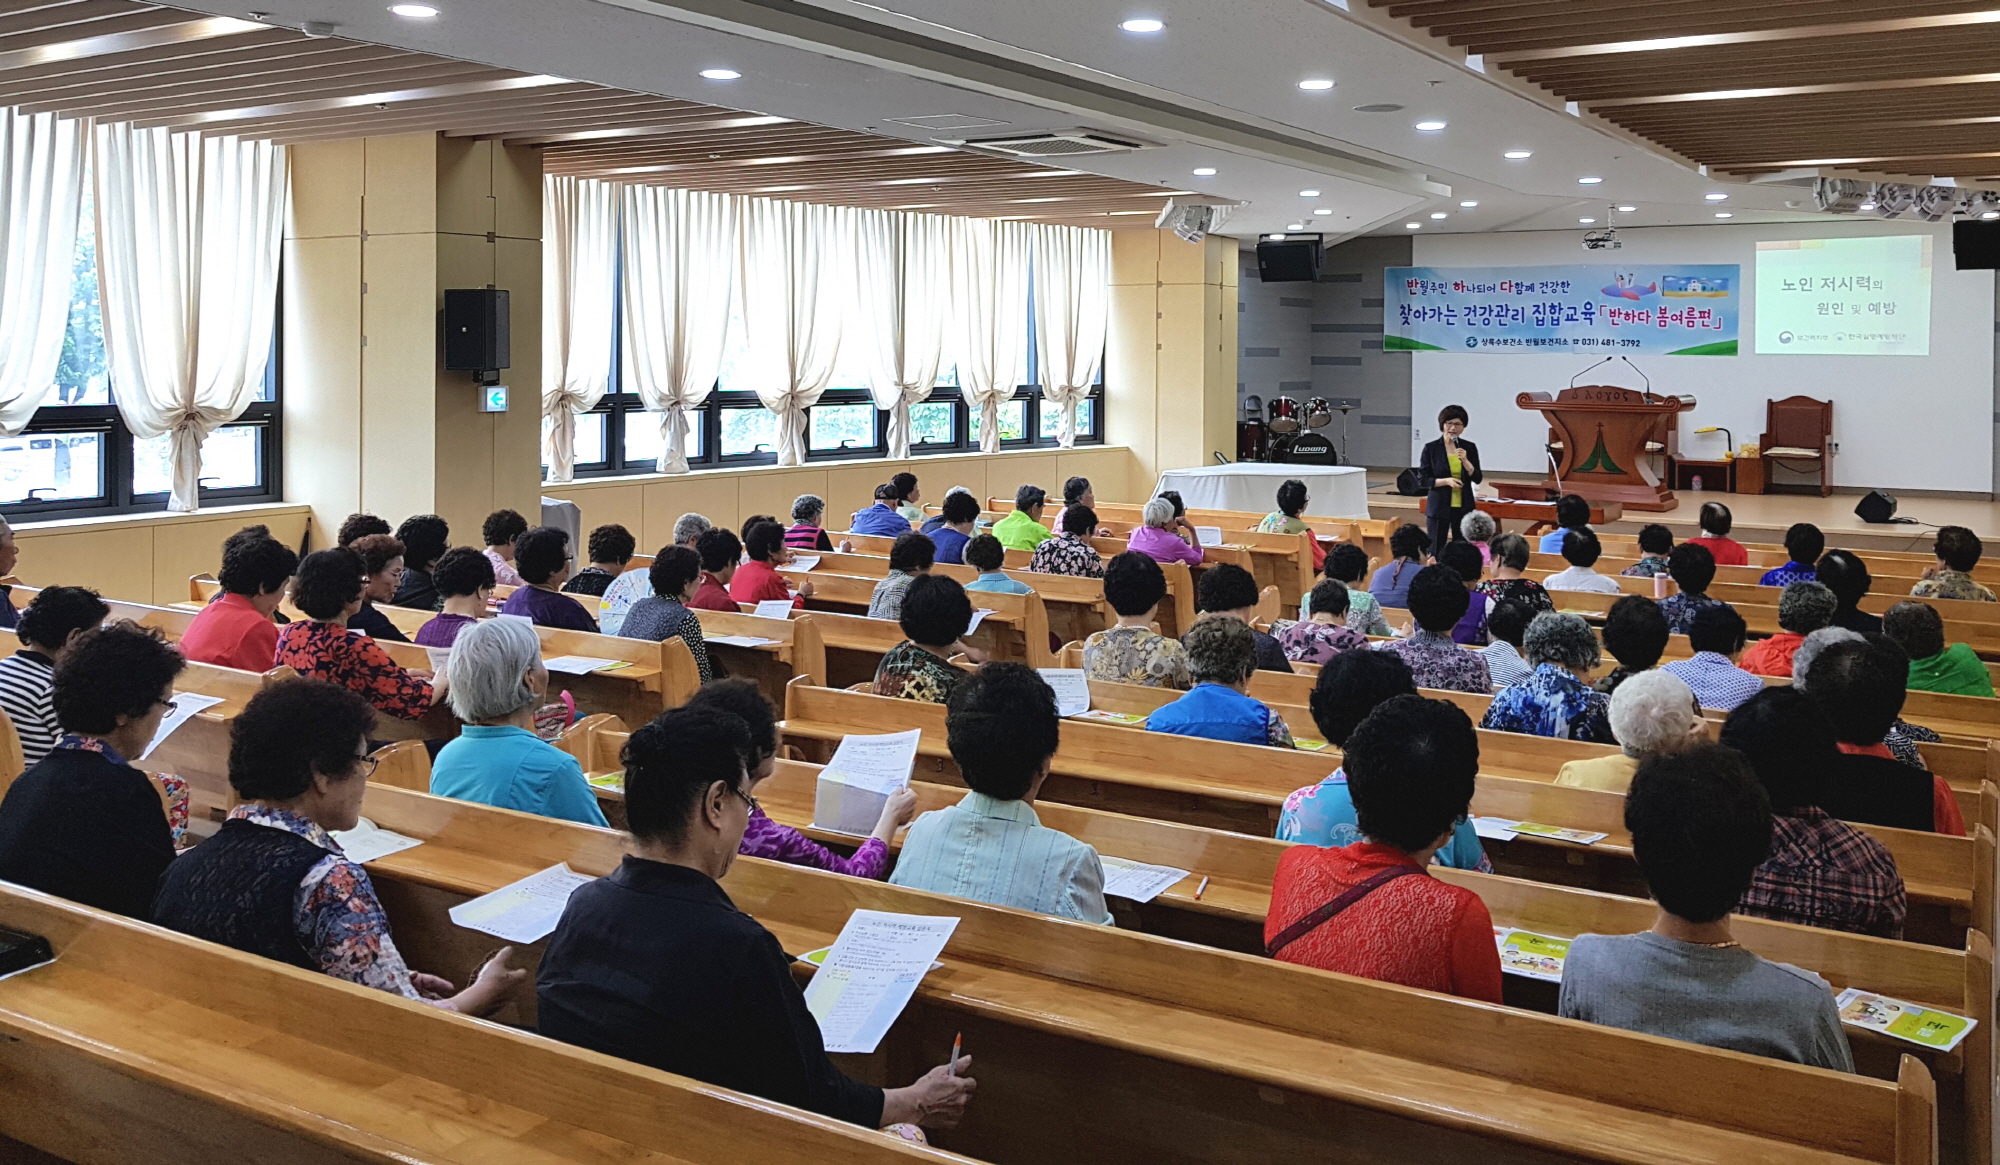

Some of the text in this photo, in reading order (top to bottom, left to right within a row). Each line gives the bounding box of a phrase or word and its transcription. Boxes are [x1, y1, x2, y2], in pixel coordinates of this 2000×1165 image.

[1406, 278, 1571, 296] 반월주민 하나되어 다함께 건강한
[1781, 275, 1883, 292] 노인 저시력의
[1399, 303, 1458, 326] 찾아가는
[1463, 303, 1525, 327] 건강관리
[1532, 301, 1596, 327] 집합교육
[1816, 301, 1897, 316] 원인 및 예방
[1481, 337, 1641, 348] 상록수보건소 반월보건지소 031) 481-3792
